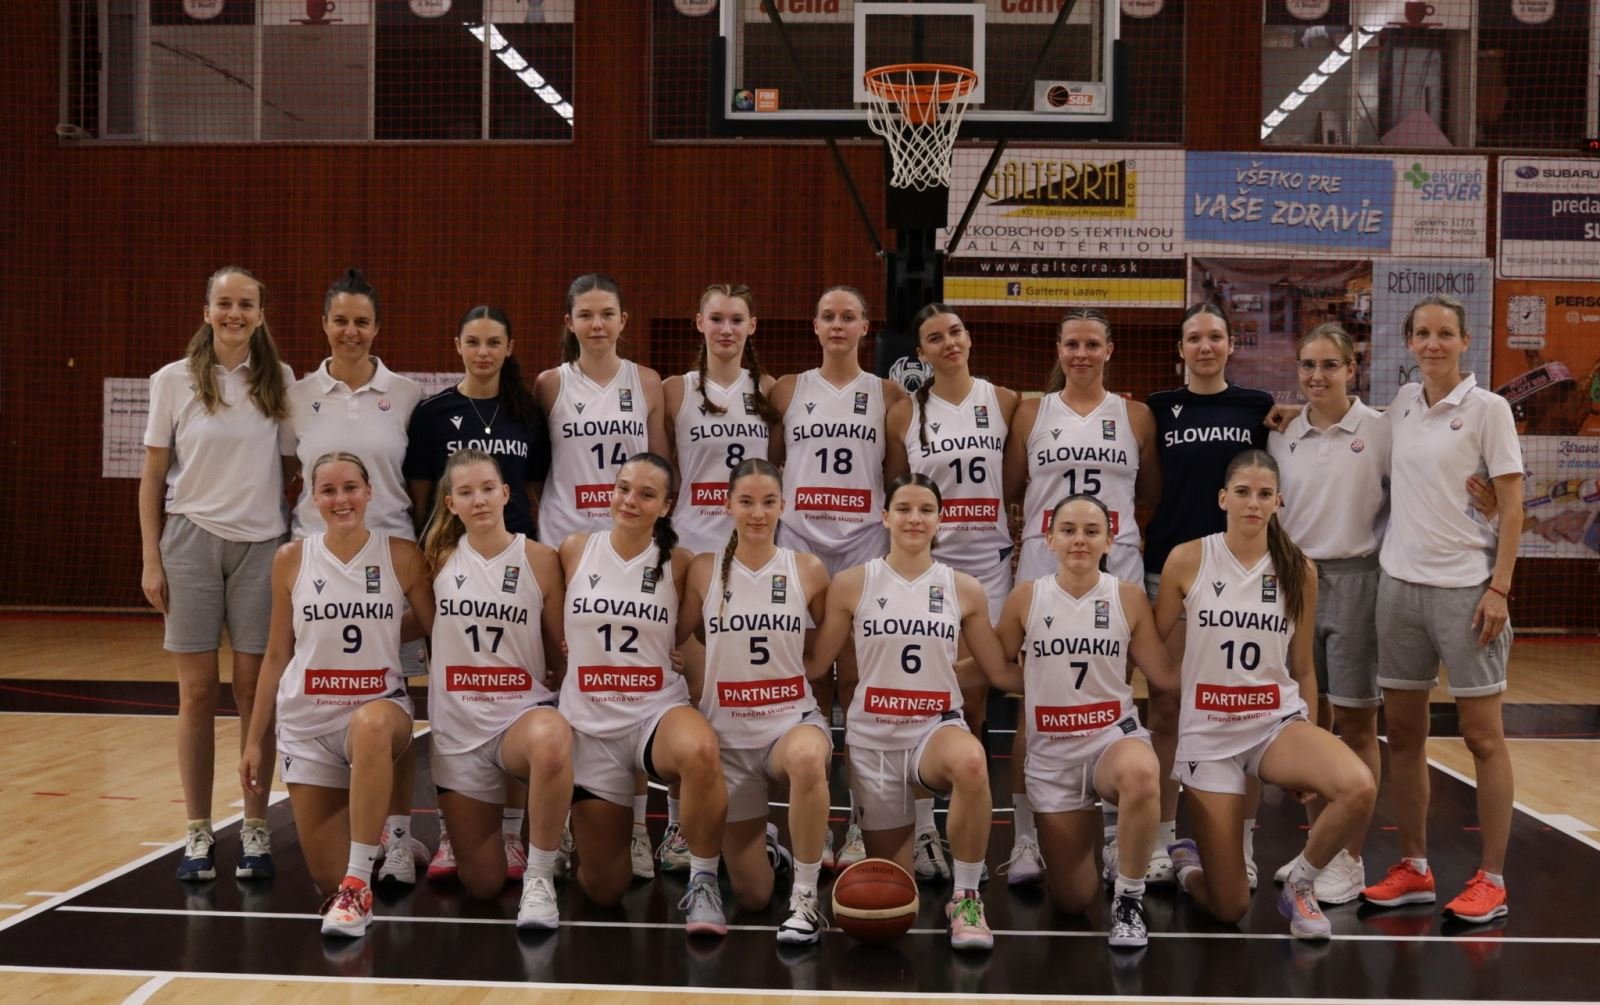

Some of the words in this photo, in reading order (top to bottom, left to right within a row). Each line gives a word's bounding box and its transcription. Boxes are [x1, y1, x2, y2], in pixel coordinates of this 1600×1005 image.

[1069, 95, 1091, 105] SBL
[1308, 174, 1342, 194] PRE
[1543, 169, 1600, 179] SUBARU
[1420, 183, 1482, 201] SEVER
[1194, 188, 1264, 222] VAŠE
[945, 225, 1065, 238] VĽKOOBCHOD
[1070, 227, 1078, 237] S
[1086, 227, 1173, 239] TEXTILNOU
[1026, 286, 1070, 296] Galterra
[1073, 286, 1109, 299] Lazany
[562, 420, 644, 438] SLOVAKIA
[690, 423, 769, 442] SLOVAKIA
[793, 423, 877, 443] SLOVAKIA
[1164, 427, 1252, 447] SLOVAKIA
[447, 439, 528, 458] SLOVAKIA
[591, 442, 627, 469] 14
[726, 443, 745, 469] 8
[921, 435, 1002, 457] SLOVAKIA
[815, 447, 853, 474] 18
[1037, 447, 1128, 466] SLOVAKIA
[949, 457, 986, 484] 16
[1062, 469, 1101, 496] 15
[798, 494, 864, 507] PARTNERS
[941, 504, 996, 517] ARTNERS
[303, 602, 393, 622] SLOVAKIA
[440, 599, 528, 625] SLOVAKIA
[572, 598, 669, 624] SLOVAKIA
[709, 614, 801, 634] SLOVAKIA
[863, 618, 955, 642] SLOVAKIA
[1199, 610, 1288, 635] SLOVAKIA
[342, 624, 363, 654] 9
[465, 624, 504, 653] 17
[597, 624, 639, 653] 12
[1033, 638, 1120, 658] SLOVAKIA
[750, 636, 770, 665] 5
[901, 644, 922, 674] 6
[1220, 640, 1261, 671] 10
[312, 675, 384, 689] PARTNERS
[453, 673, 526, 687] PARTNERS
[584, 673, 657, 687] PARTNERS
[1070, 661, 1088, 690] 7
[724, 684, 799, 701] PARTNERS
[870, 694, 944, 711] PARTNERS
[1202, 691, 1275, 706] PARTNERS
[1042, 709, 1115, 726] PARTNERS
